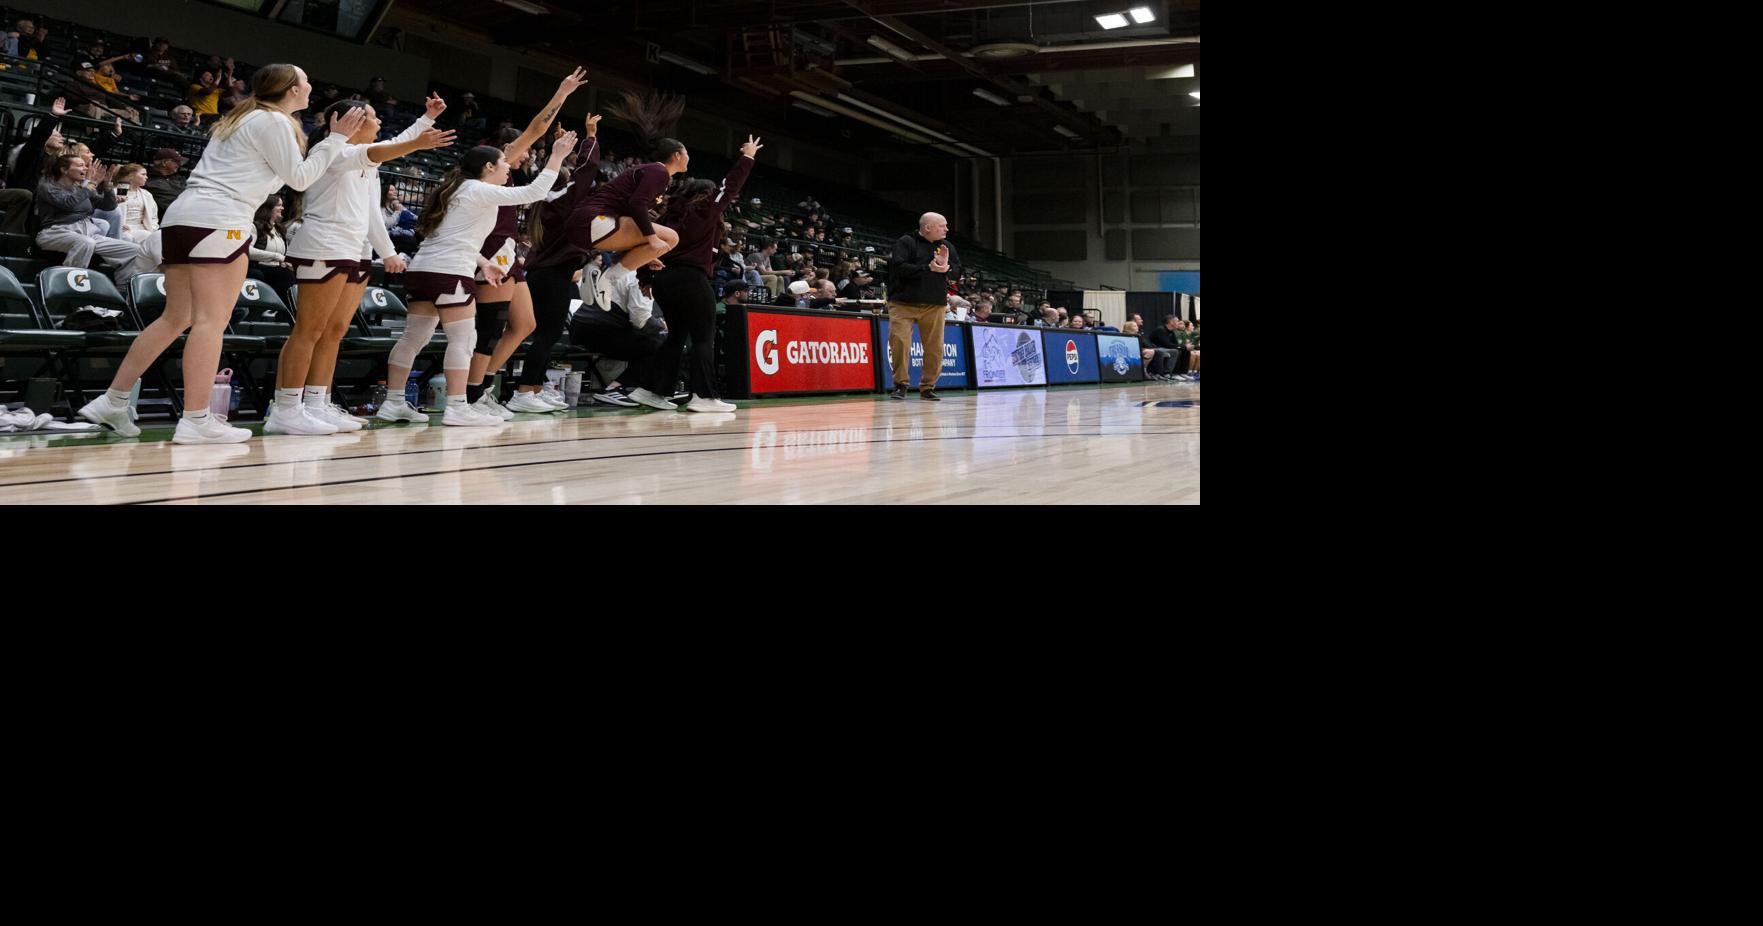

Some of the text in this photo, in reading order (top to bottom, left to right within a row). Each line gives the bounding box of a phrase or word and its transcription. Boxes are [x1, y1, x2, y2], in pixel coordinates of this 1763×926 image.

[67, 269, 91, 292] G
[241, 280, 260, 301] G
[371, 288, 388, 307] G
[755, 329, 869, 375] G GATORADE
[910, 342, 957, 358] HATON
